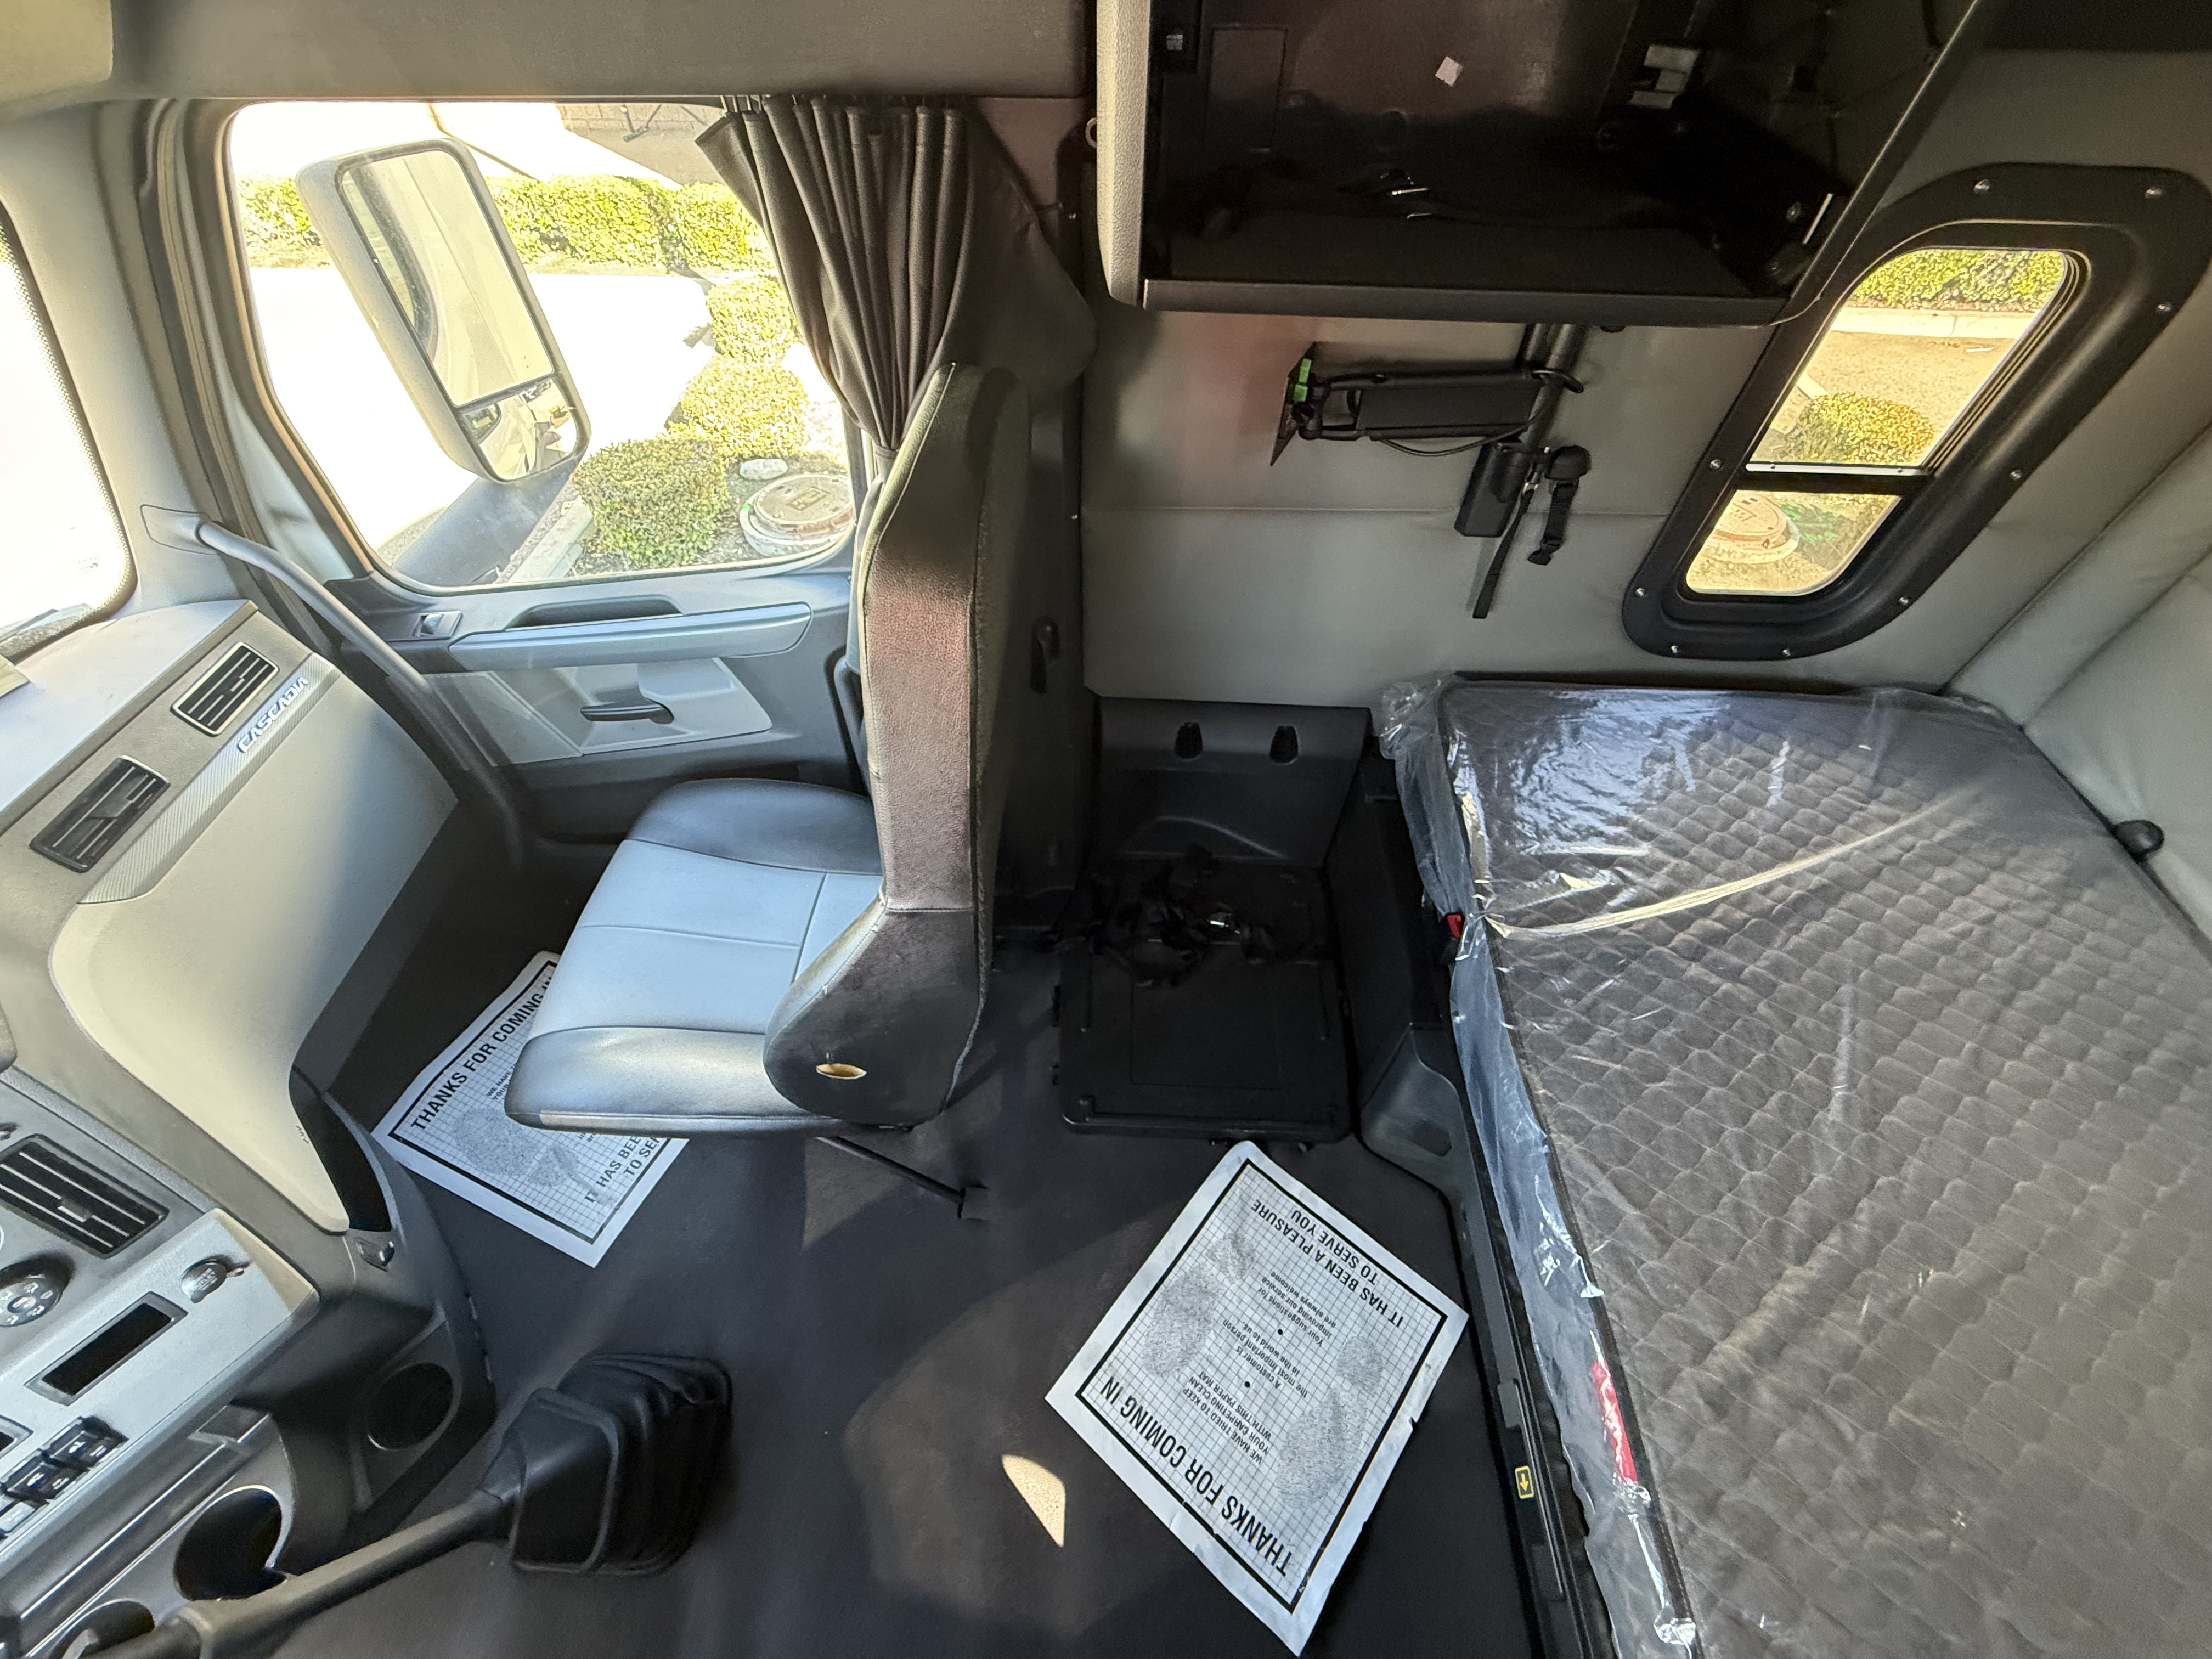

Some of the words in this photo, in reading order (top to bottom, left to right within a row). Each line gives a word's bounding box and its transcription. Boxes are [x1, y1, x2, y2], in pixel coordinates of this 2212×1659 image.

[237, 677, 309, 753] CASCADIA
[410, 1073, 467, 1129] THANKS
[463, 1043, 497, 1071] FOR
[492, 994, 543, 1042] COMING
[486, 1087, 498, 1096] WE
[496, 1071, 511, 1086] HAVE
[596, 1160, 622, 1187] HAS
[618, 1136, 642, 1159] BEE
[623, 1159, 642, 1176] TO
[1251, 1200, 1313, 1255] PLEASURE
[1291, 1210, 1316, 1236] YOU
[1315, 1250, 1325, 1263] A
[1318, 1231, 1359, 1268] SERVE
[1324, 1259, 1359, 1292] BEEN
[1361, 1266, 1377, 1285] TO
[1256, 1288, 1268, 1299] for
[1262, 1277, 1286, 1299] service
[1285, 1298, 1297, 1309] our
[1300, 1296, 1323, 1317] always
[1359, 1288, 1388, 1315] HAS
[1269, 1296, 1307, 1331] suggestions
[1297, 1306, 1332, 1340] improving
[1324, 1316, 1336, 1328] are
[1388, 1312, 1403, 1328] IT
[1223, 1318, 1246, 1341] person
[1253, 1332, 1261, 1342] to
[1307, 1330, 1324, 1347] Your
[1235, 1346, 1243, 1356] is
[1244, 1338, 1278, 1372] important
[1260, 1339, 1279, 1358] world
[1243, 1353, 1274, 1383] customer
[1280, 1356, 1291, 1369] the
[1292, 1367, 1300, 1377] in
[1189, 1376, 1211, 1399] CLEAN
[1198, 1371, 1214, 1387] MAT
[1273, 1380, 1281, 1389] A
[1277, 1368, 1295, 1386] most
[1100, 1376, 1123, 1405] IN
[1183, 1389, 1201, 1406] KEEP
[1214, 1384, 1236, 1408] PAPER
[1296, 1383, 1308, 1398] the
[1201, 1403, 1210, 1415] TO
[1211, 1397, 1249, 1435] CARPETING
[1235, 1404, 1252, 1423] THIS
[1120, 1395, 1187, 1468] COMING
[1211, 1413, 1231, 1435] TRIED
[1252, 1420, 1271, 1441] WITH
[1231, 1431, 1250, 1453] HAVE
[1249, 1432, 1268, 1456] YOUR
[1250, 1449, 1262, 1465] WE
[1185, 1458, 1224, 1505] FOR
[1222, 1496, 1292, 1577] THANKS
